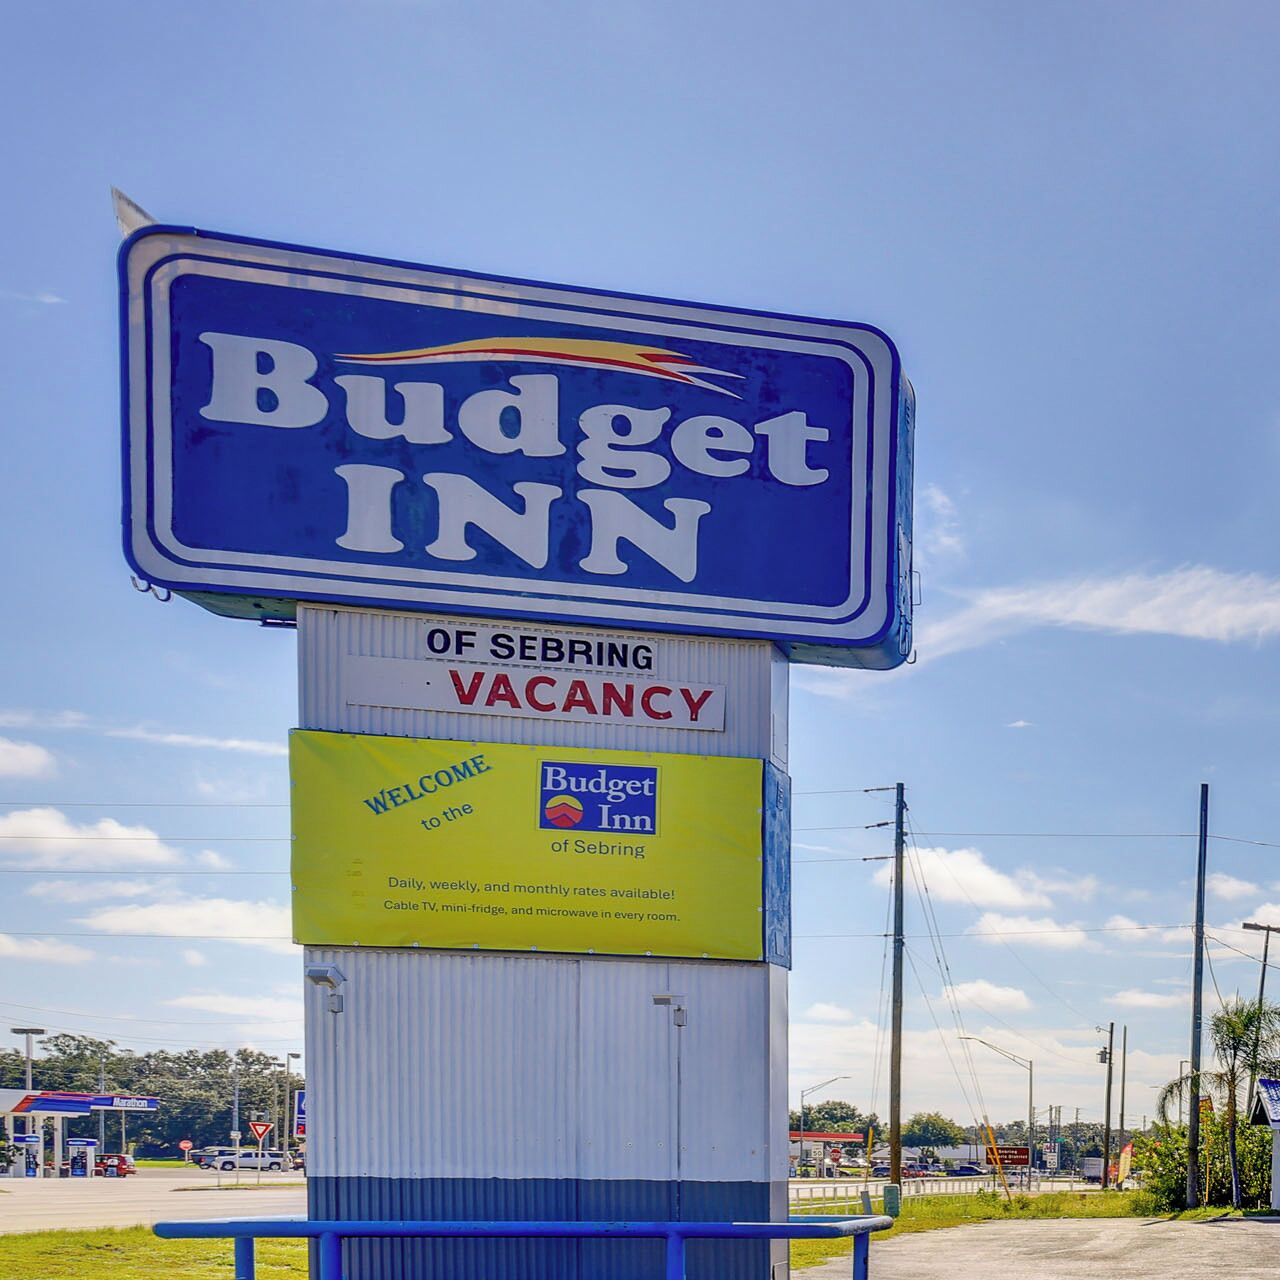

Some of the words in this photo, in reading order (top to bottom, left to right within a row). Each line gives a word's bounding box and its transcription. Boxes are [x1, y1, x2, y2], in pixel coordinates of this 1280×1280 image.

[199, 332, 829, 488] Budget
[334, 463, 711, 582] INN
[426, 628, 477, 655] OF
[490, 633, 653, 671] SEBRING
[449, 669, 714, 722] VACANCY
[363, 754, 493, 815] WELCOME
[543, 766, 655, 803] Budget
[420, 816, 441, 831] to
[442, 803, 474, 822] the
[597, 804, 653, 831] Inn
[551, 839, 569, 853] of
[574, 840, 646, 859] Sebring
[388, 876, 426, 891] Daily,
[430, 880, 480, 893] weekly,
[484, 882, 510, 892] and
[513, 884, 570, 897] monthly
[573, 887, 607, 897] rates
[610, 888, 675, 900] available!
[384, 900, 419, 911] Cable
[421, 901, 439, 912] TV,
[441, 903, 508, 916] mini-fridge,
[511, 906, 533, 915] and
[536, 907, 599, 918] microwave
[601, 910, 612, 918] in
[614, 911, 644, 922] every
[647, 912, 681, 921] room.
[113, 1096, 148, 1108] Marathon
